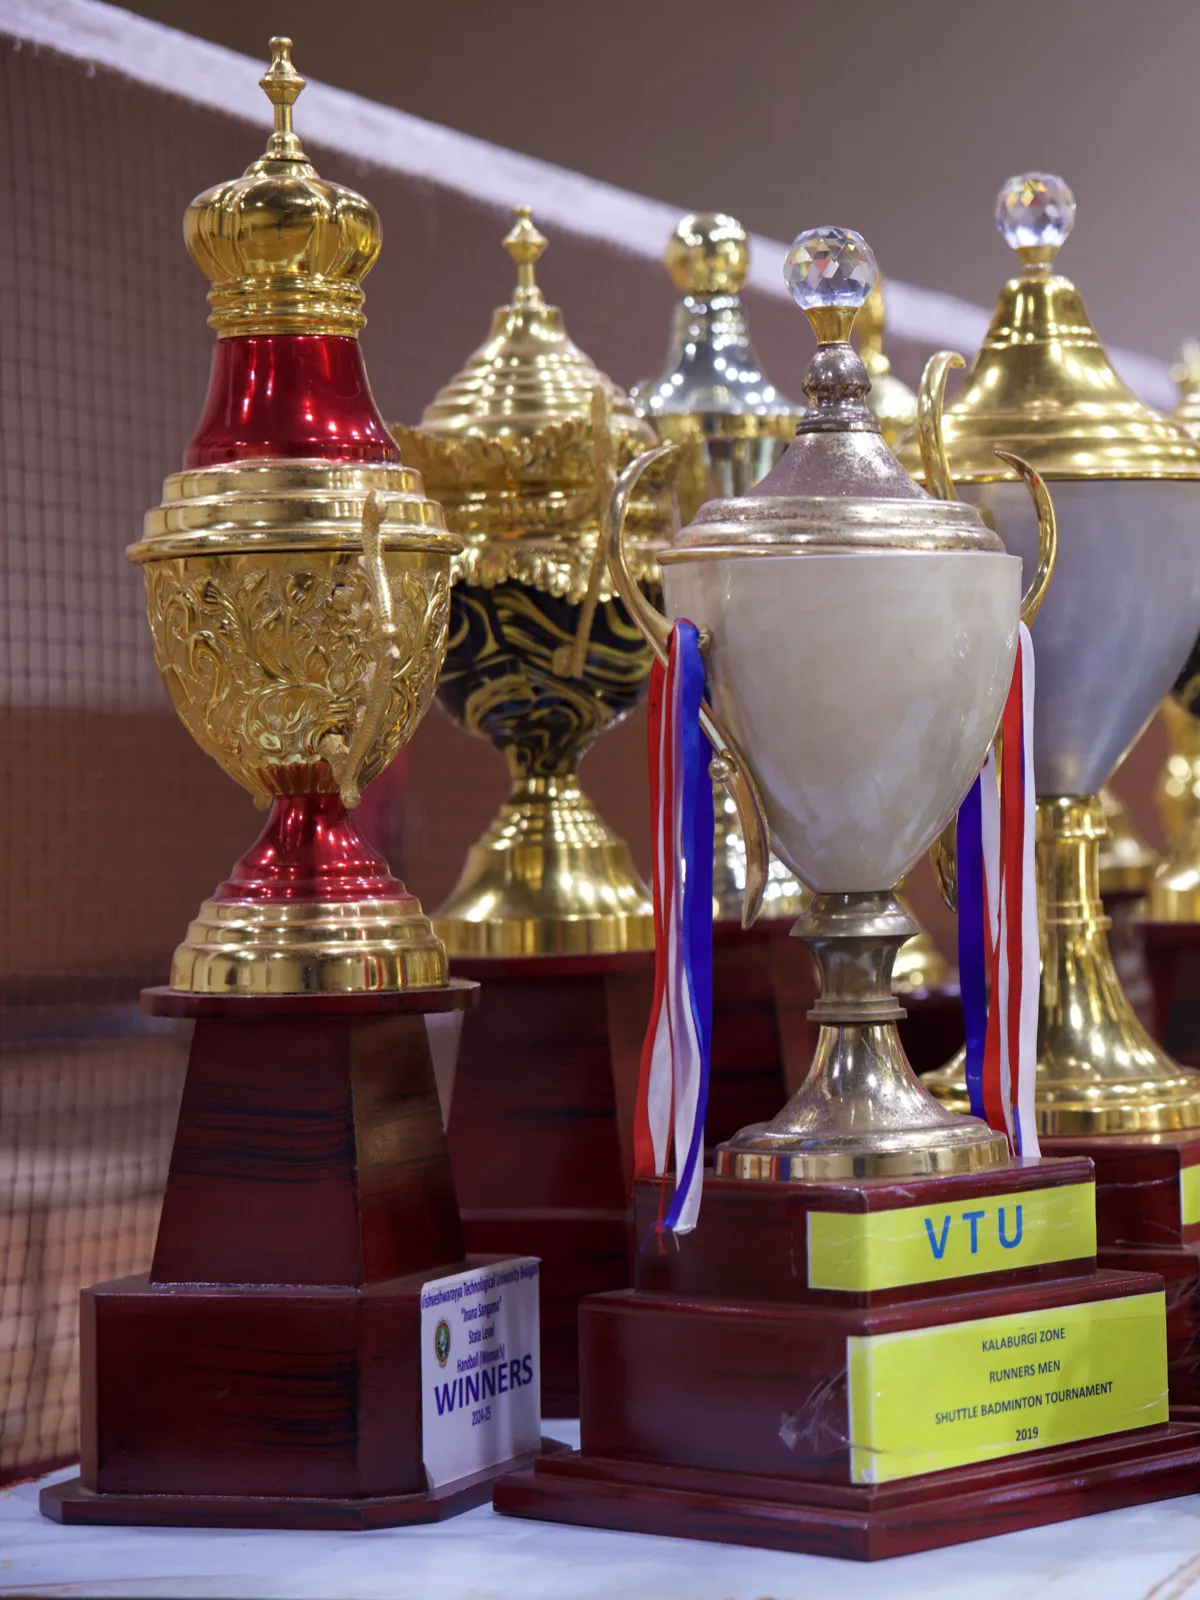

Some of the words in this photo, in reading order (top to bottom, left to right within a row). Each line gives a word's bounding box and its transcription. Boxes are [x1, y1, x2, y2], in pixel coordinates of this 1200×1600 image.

[924, 1205, 1023, 1259] VTU
[463, 1273, 496, 1296] Technological
[496, 1268, 520, 1286] University
[468, 1329, 482, 1345] State
[482, 1322, 495, 1341] Level
[981, 1331, 1038, 1353] KALABURGI
[1039, 1327, 1066, 1343] ZONE
[457, 1352, 479, 1373] Handball
[989, 1363, 1036, 1384] RUNNERS
[1038, 1359, 1061, 1376] MEN
[434, 1354, 533, 1416] WINNERS
[935, 1405, 979, 1425] SHUTTLE
[980, 1395, 1043, 1417] BADMINTON
[1045, 1381, 1113, 1405] TOURNAMENT
[1015, 1426, 1039, 1442] 2019
